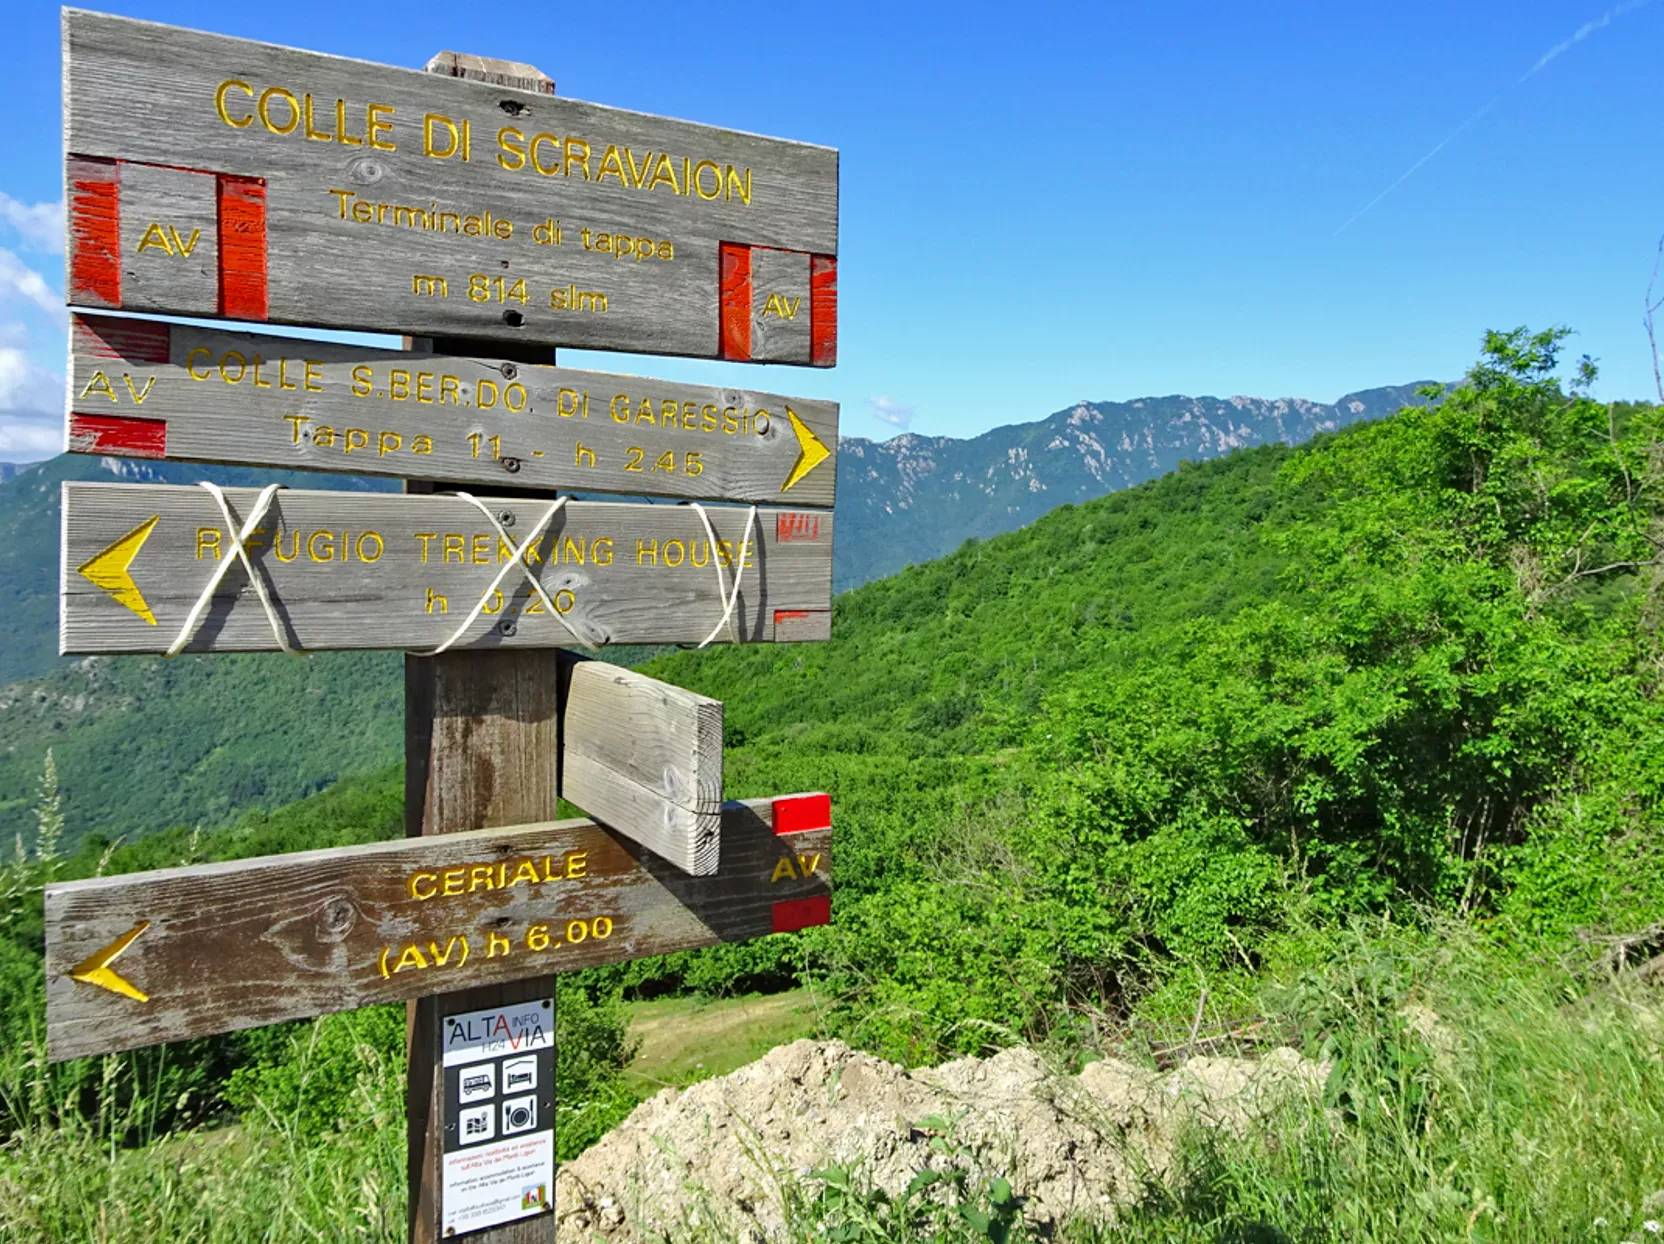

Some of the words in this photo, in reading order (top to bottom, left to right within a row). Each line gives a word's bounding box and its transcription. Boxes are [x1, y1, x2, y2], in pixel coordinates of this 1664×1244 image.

[214, 78, 397, 151] COLLE
[423, 113, 471, 162] DI
[496, 126, 753, 205] SCRAVAION
[137, 223, 201, 258] AV
[328, 189, 514, 240] Terminale
[532, 214, 563, 246] di
[580, 227, 675, 262] tappa
[412, 274, 448, 298] m
[467, 273, 531, 305] 814
[550, 283, 609, 313] slm
[762, 293, 801, 320] AV
[81, 371, 156, 405] AV
[185, 347, 325, 392] COLLE
[557, 387, 589, 419] DI
[609, 393, 771, 436] GARESSIO
[283, 415, 433, 457] Tappa
[466, 432, 502, 460] 11
[575, 441, 597, 468] h
[624, 446, 704, 476] 2.45
[413, 532, 615, 567] TREKKING
[425, 587, 449, 615] h
[407, 851, 588, 900] CERIALE
[771, 853, 821, 883] AV
[377, 936, 470, 980] (AV)
[486, 932, 511, 959] h
[526, 916, 614, 951] 6.00
[512, 1012, 540, 1028] INFO
